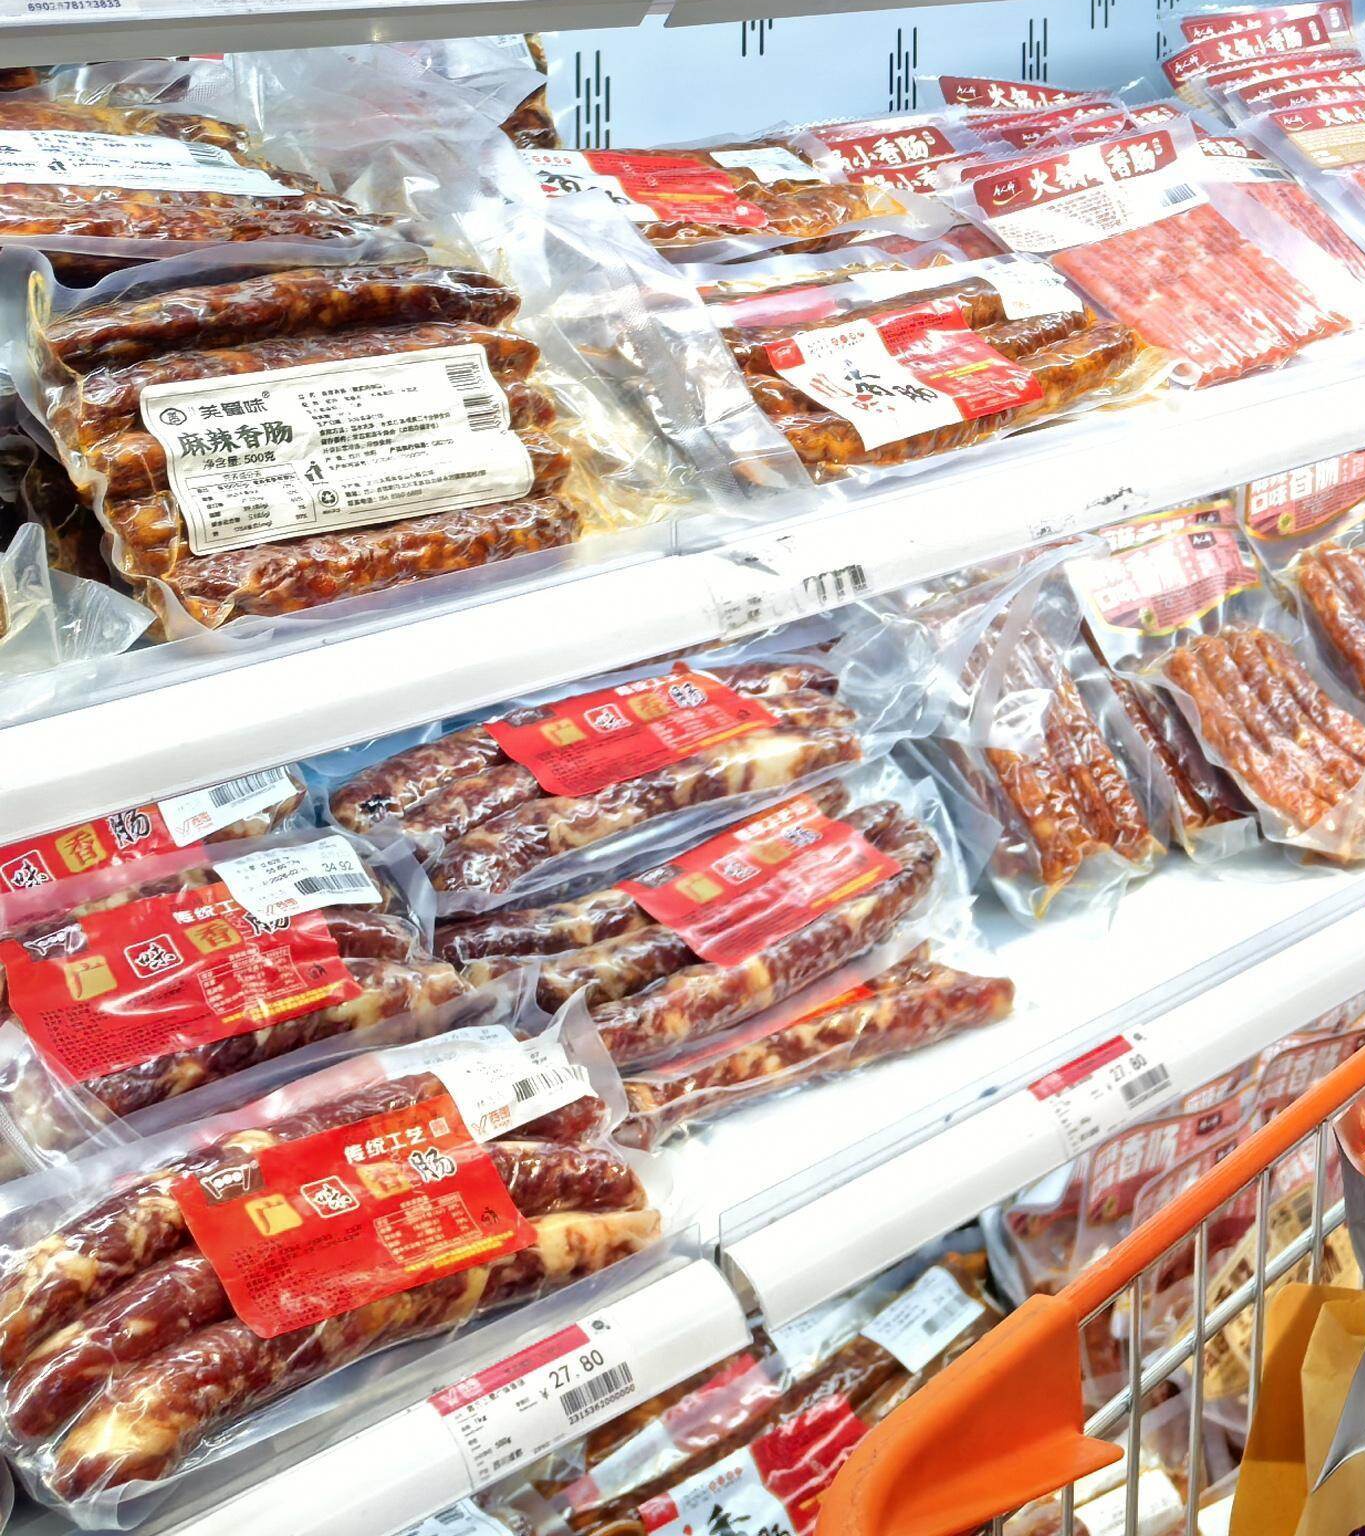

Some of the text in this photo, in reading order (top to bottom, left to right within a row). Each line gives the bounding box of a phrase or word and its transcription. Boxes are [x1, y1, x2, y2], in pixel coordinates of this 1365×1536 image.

[1028, 140, 1157, 201] 火锅香肠
[177, 420, 293, 459] 麻辣香肠
[344, 1127, 427, 1164] 传统工艺
[548, 1347, 605, 1392] 27.80
